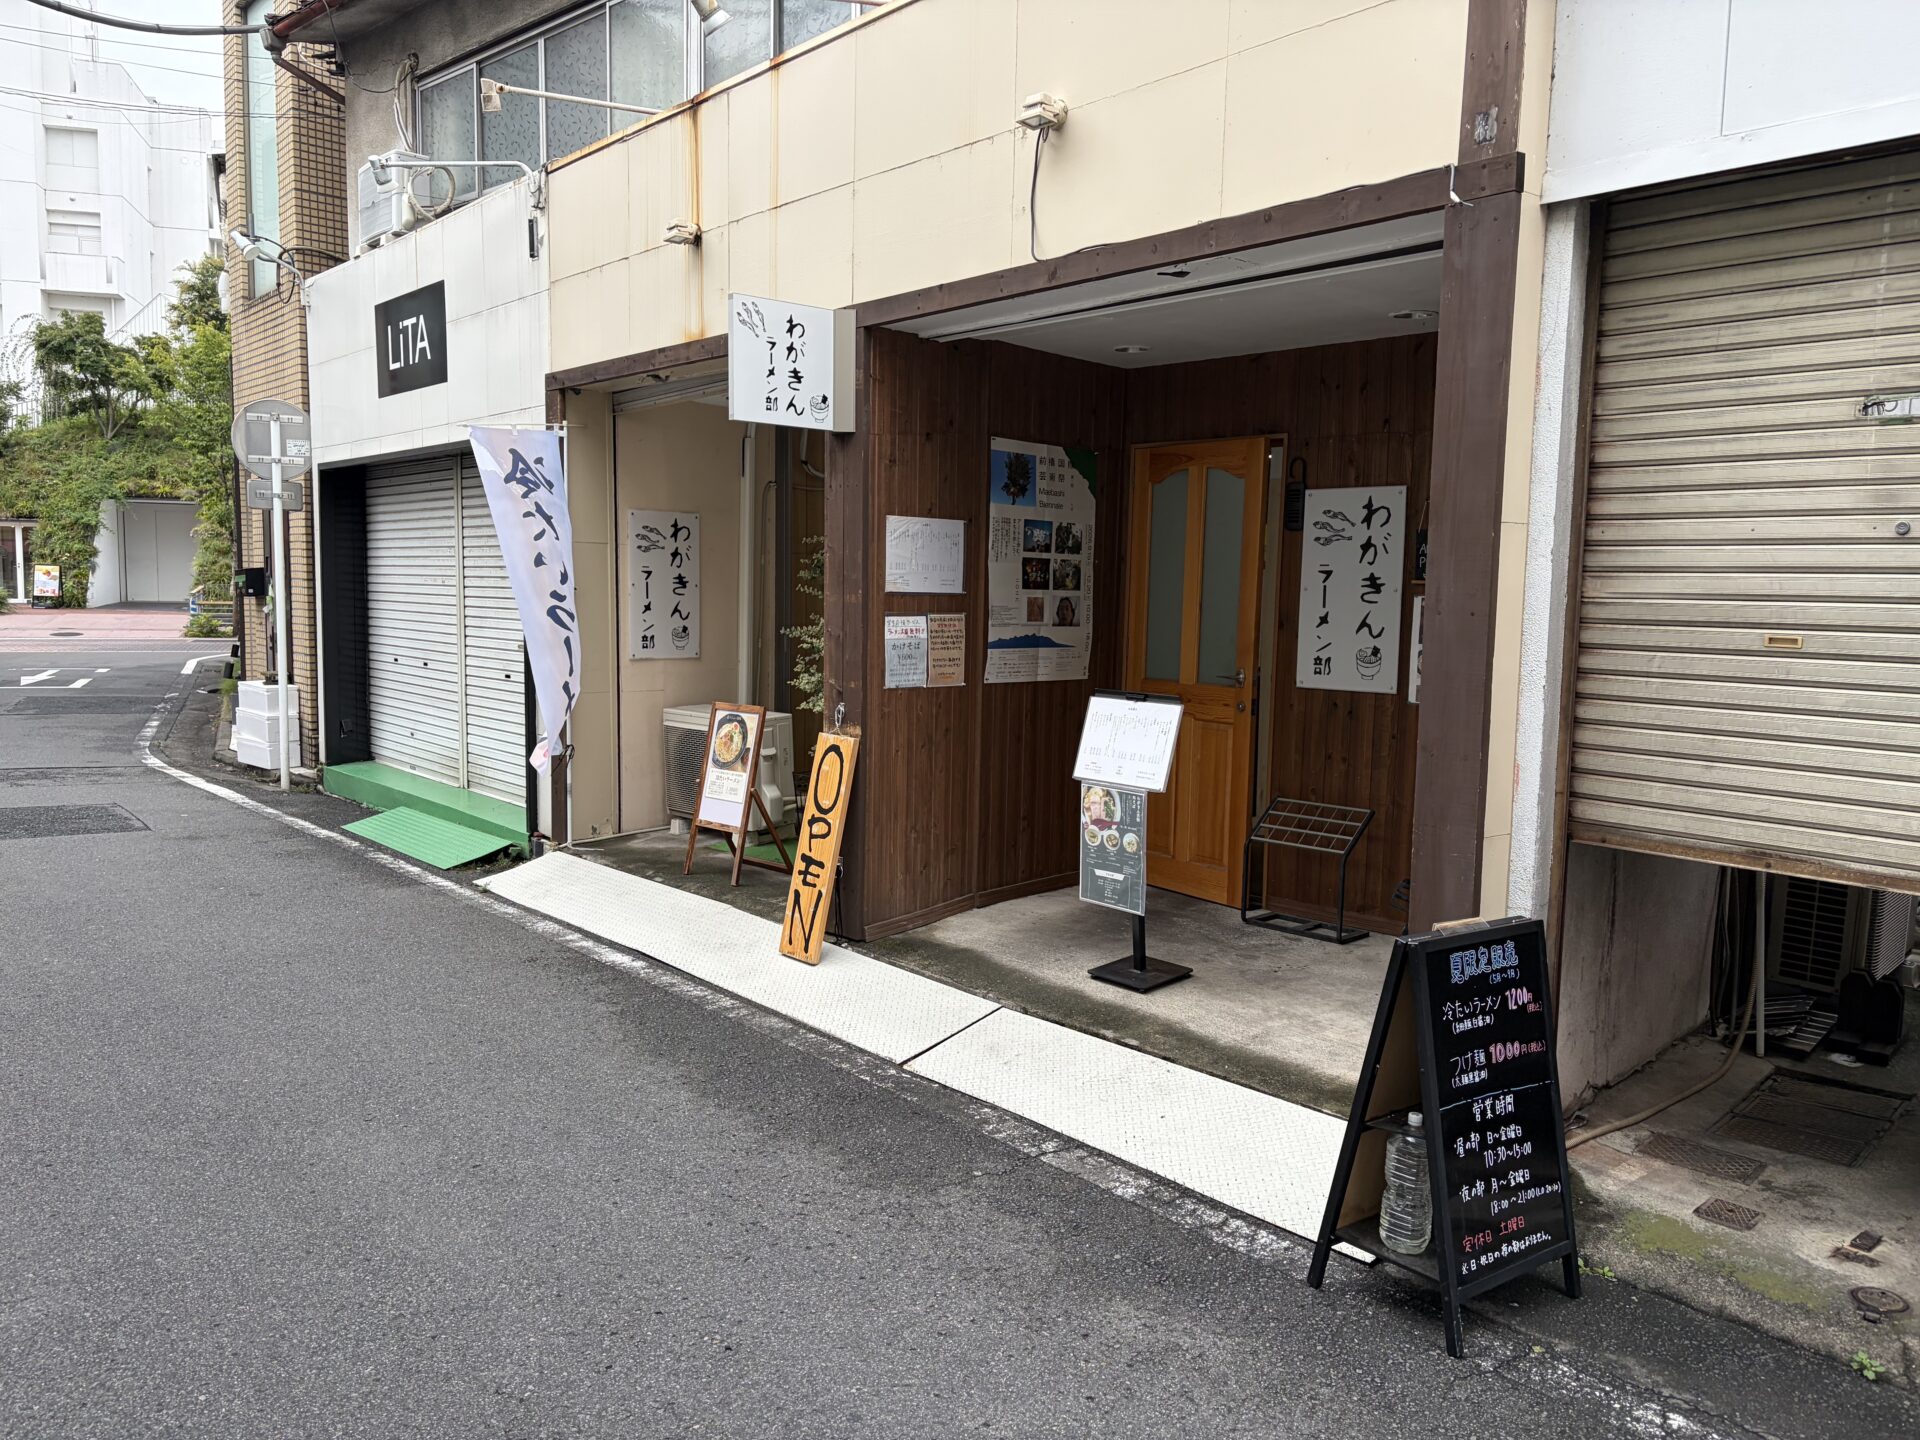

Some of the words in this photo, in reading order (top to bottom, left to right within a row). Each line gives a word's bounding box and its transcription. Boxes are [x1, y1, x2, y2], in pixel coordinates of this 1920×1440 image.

[387, 314, 431, 370] LiTA
[766, 336, 778, 413] ラーメン部
[786, 313, 806, 416] わがきん
[670, 518, 692, 621] わがきん
[1355, 495, 1392, 639] わがきん
[641, 565, 655, 649] ラーメン部
[1313, 564, 1334, 676] ラーメン部
[789, 743, 845, 955] OPEN
[1449, 940, 1519, 984] 夏限定販売
[1442, 995, 1502, 1021] 冷たいラーメン
[1450, 1049, 1486, 1076] つけ麺
[1472, 1094, 1515, 1122] 営業時間
[1462, 1230, 1493, 1253] 定休日
[1499, 1215, 1525, 1236] 土曜日
